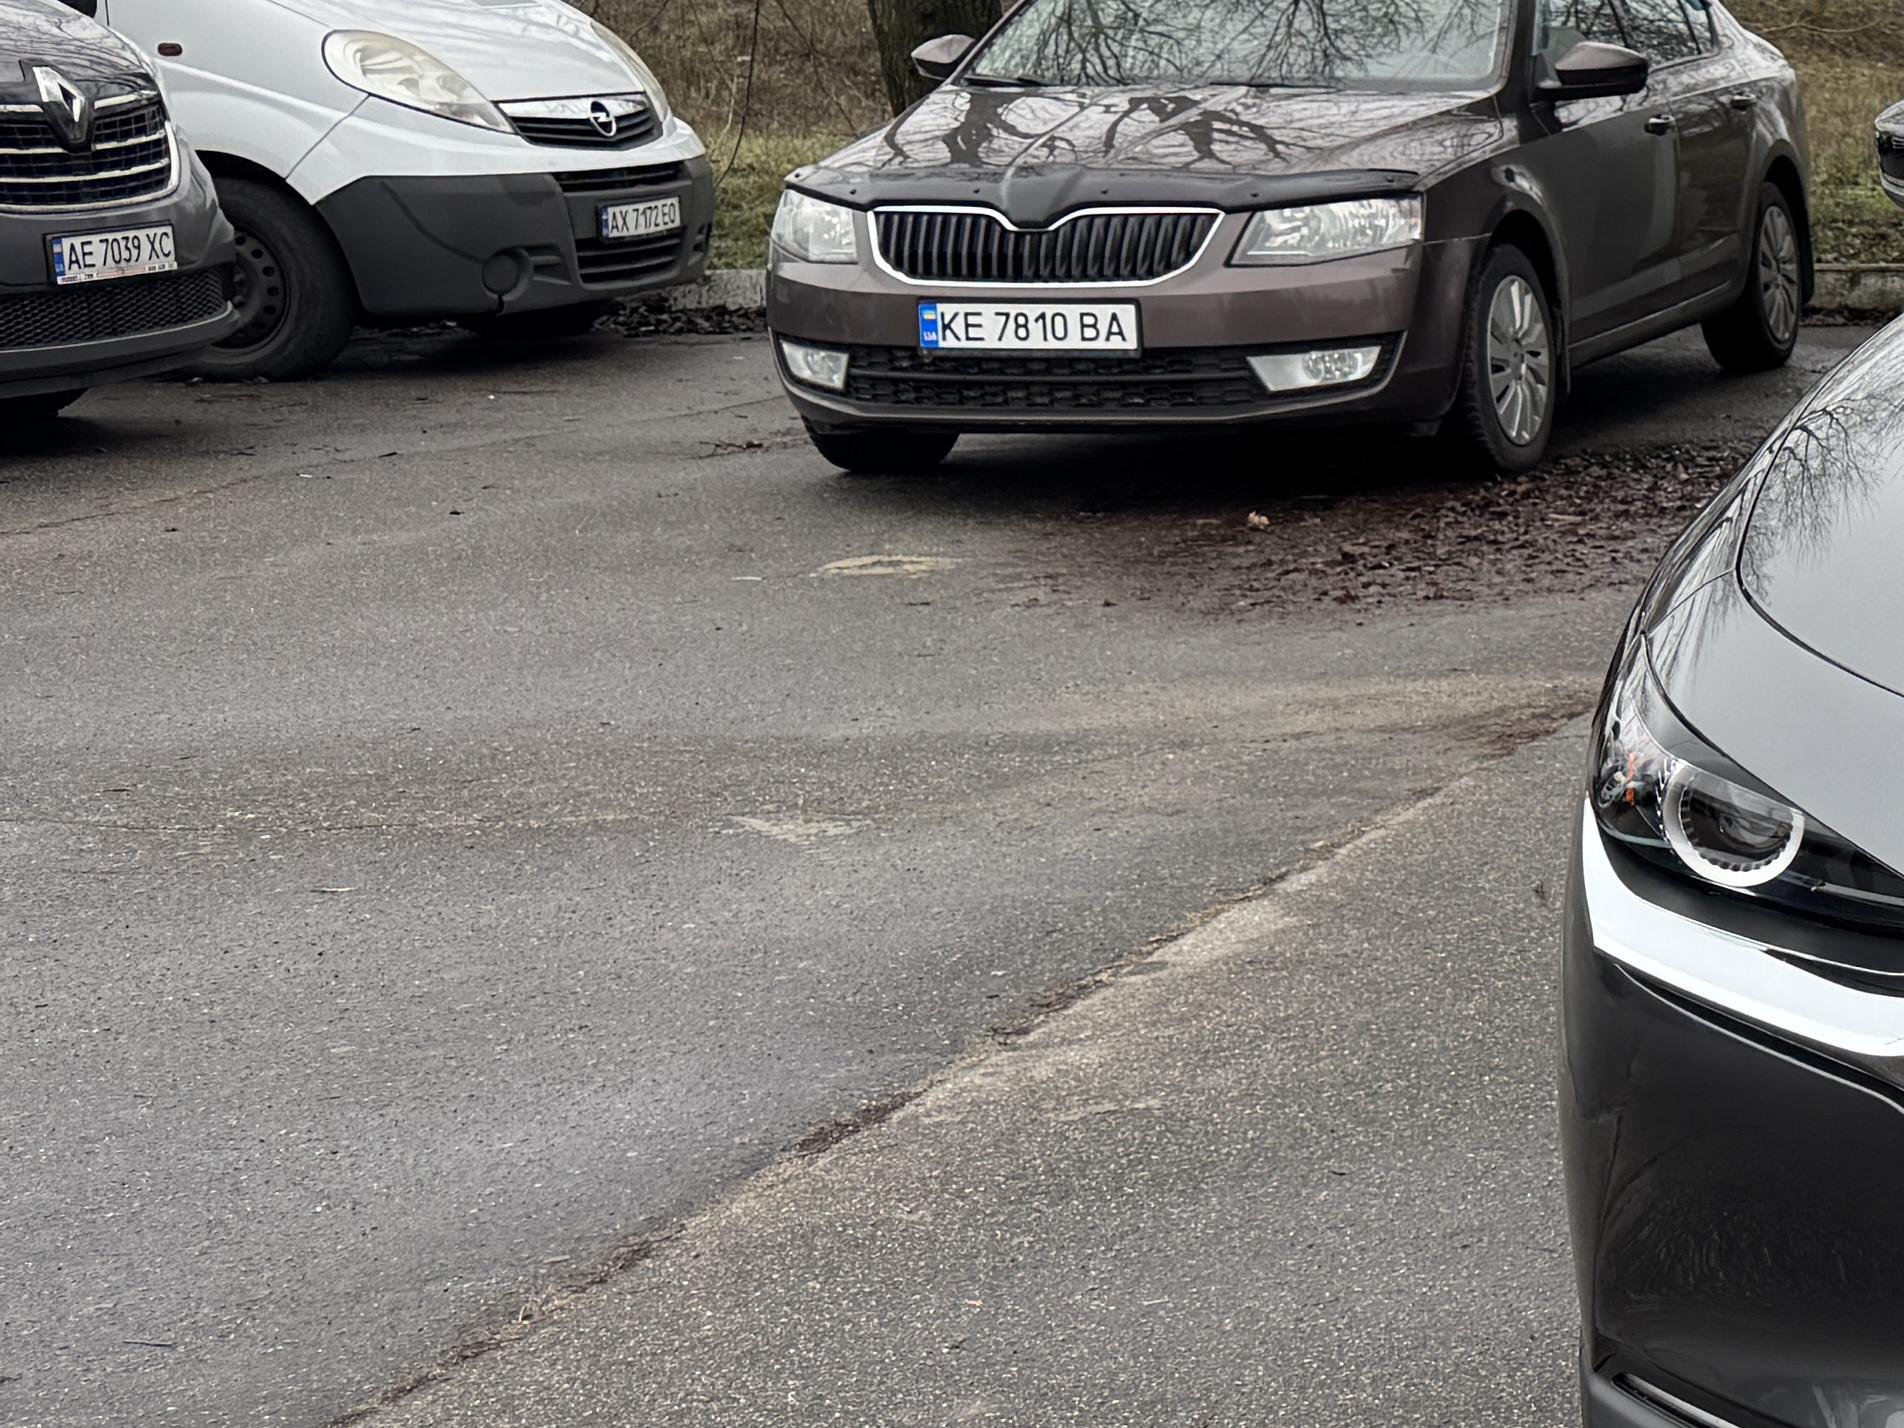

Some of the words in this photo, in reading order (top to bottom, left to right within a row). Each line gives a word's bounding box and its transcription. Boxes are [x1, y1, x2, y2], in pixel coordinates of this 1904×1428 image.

[611, 210, 629, 233] AX
[632, 205, 659, 231] 7172
[68, 241, 96, 271] AE
[99, 234, 141, 266] 7039
[145, 231, 172, 261] XC
[940, 311, 985, 342] KE
[994, 311, 1069, 342] 7810
[1079, 312, 1127, 342] BA
